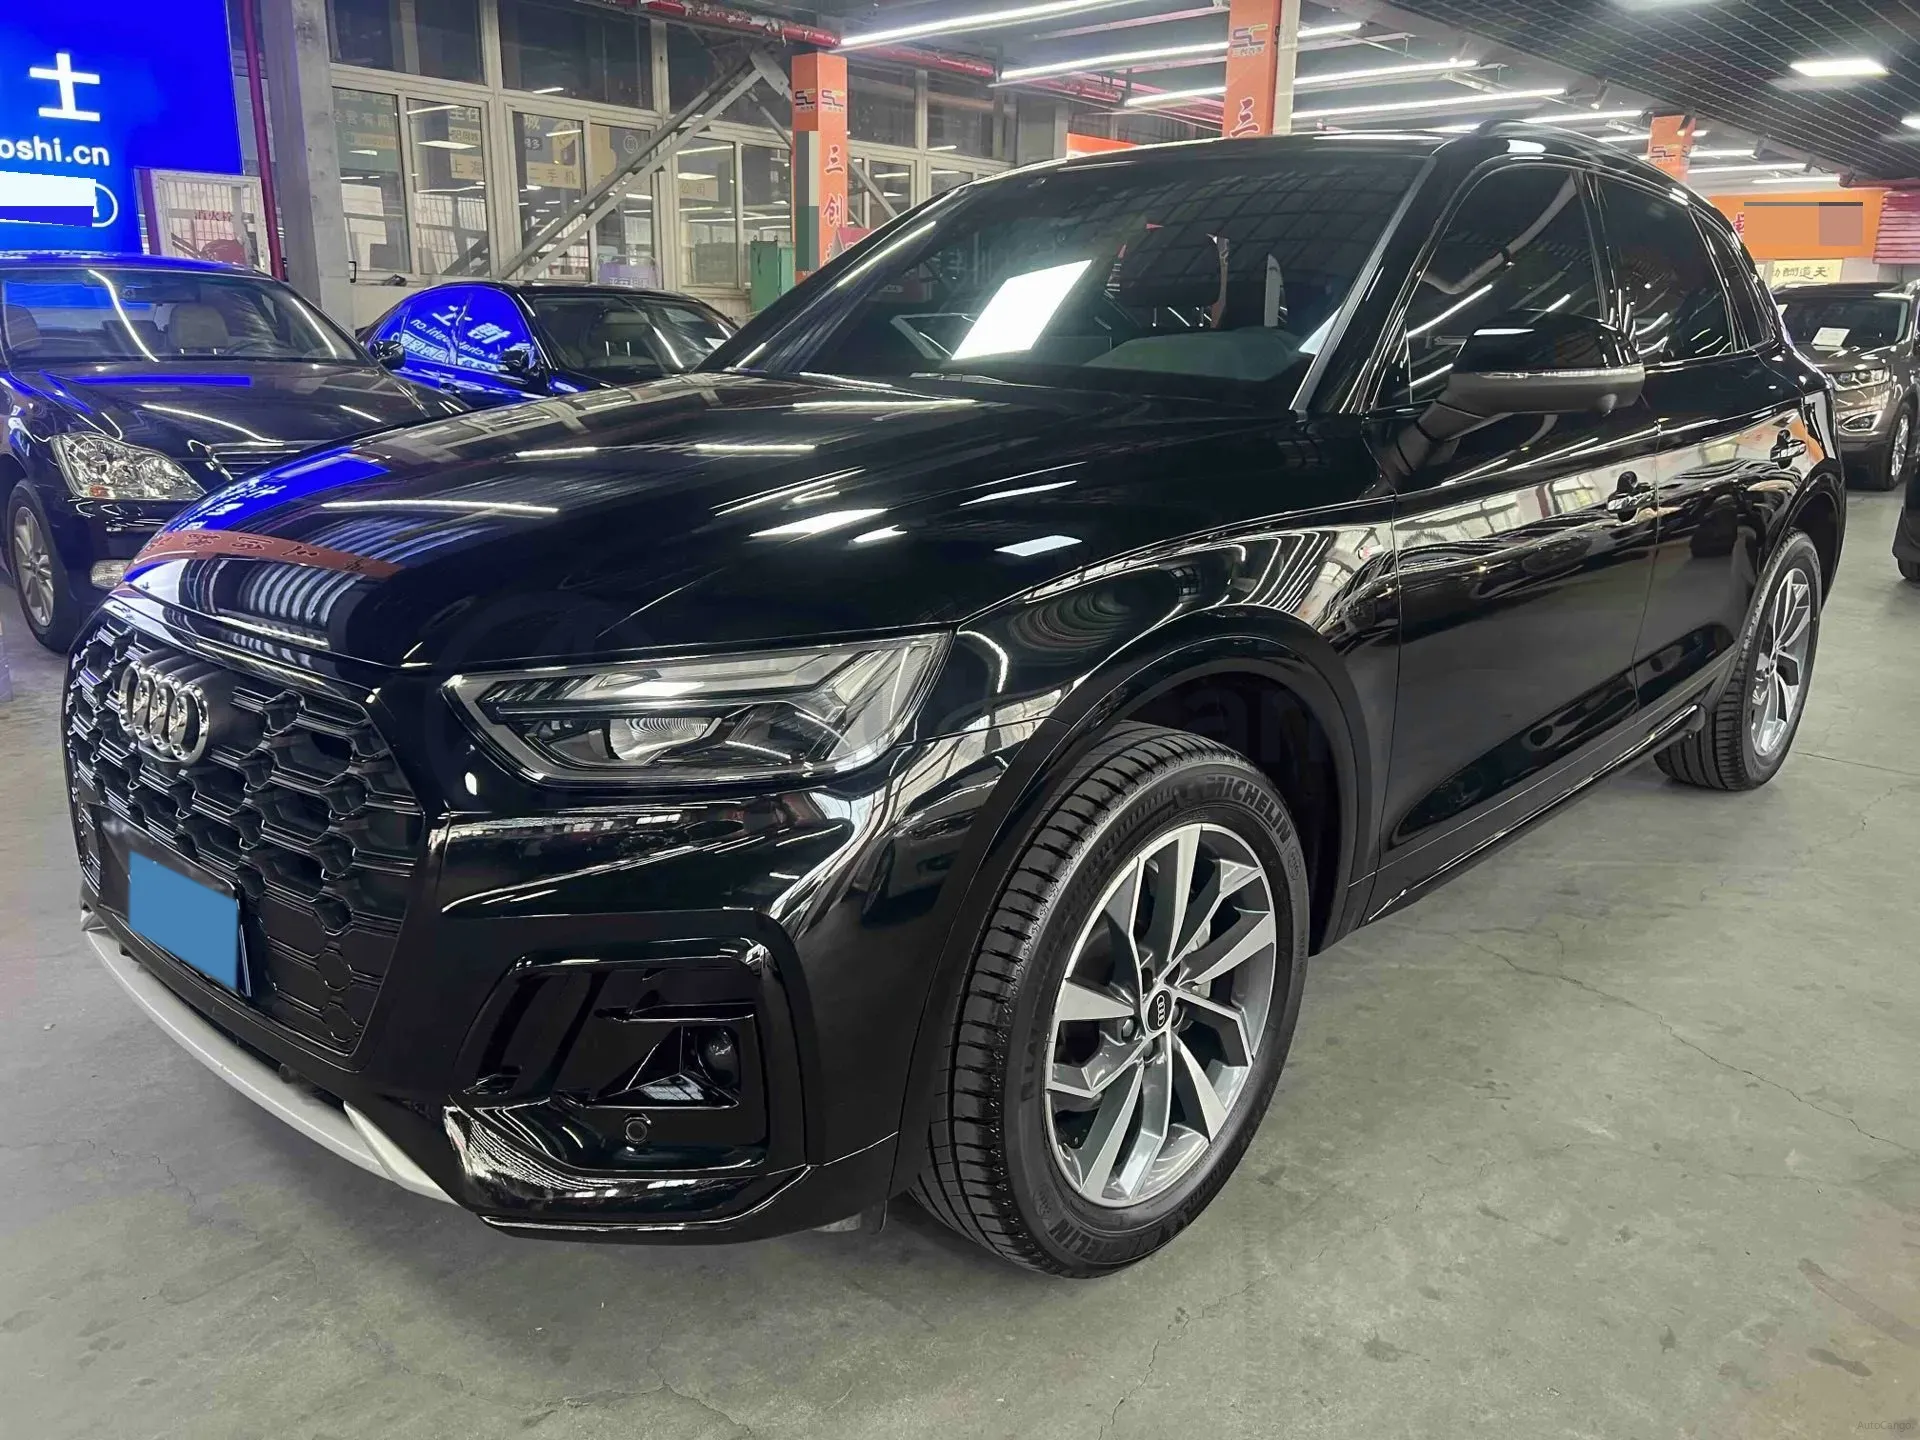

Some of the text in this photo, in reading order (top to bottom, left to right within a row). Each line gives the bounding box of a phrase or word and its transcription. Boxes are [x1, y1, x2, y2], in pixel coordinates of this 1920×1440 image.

[29, 52, 101, 122] 士
[0, 135, 110, 167] oshi.cn
[1206, 774, 1293, 844] MICHELIN
